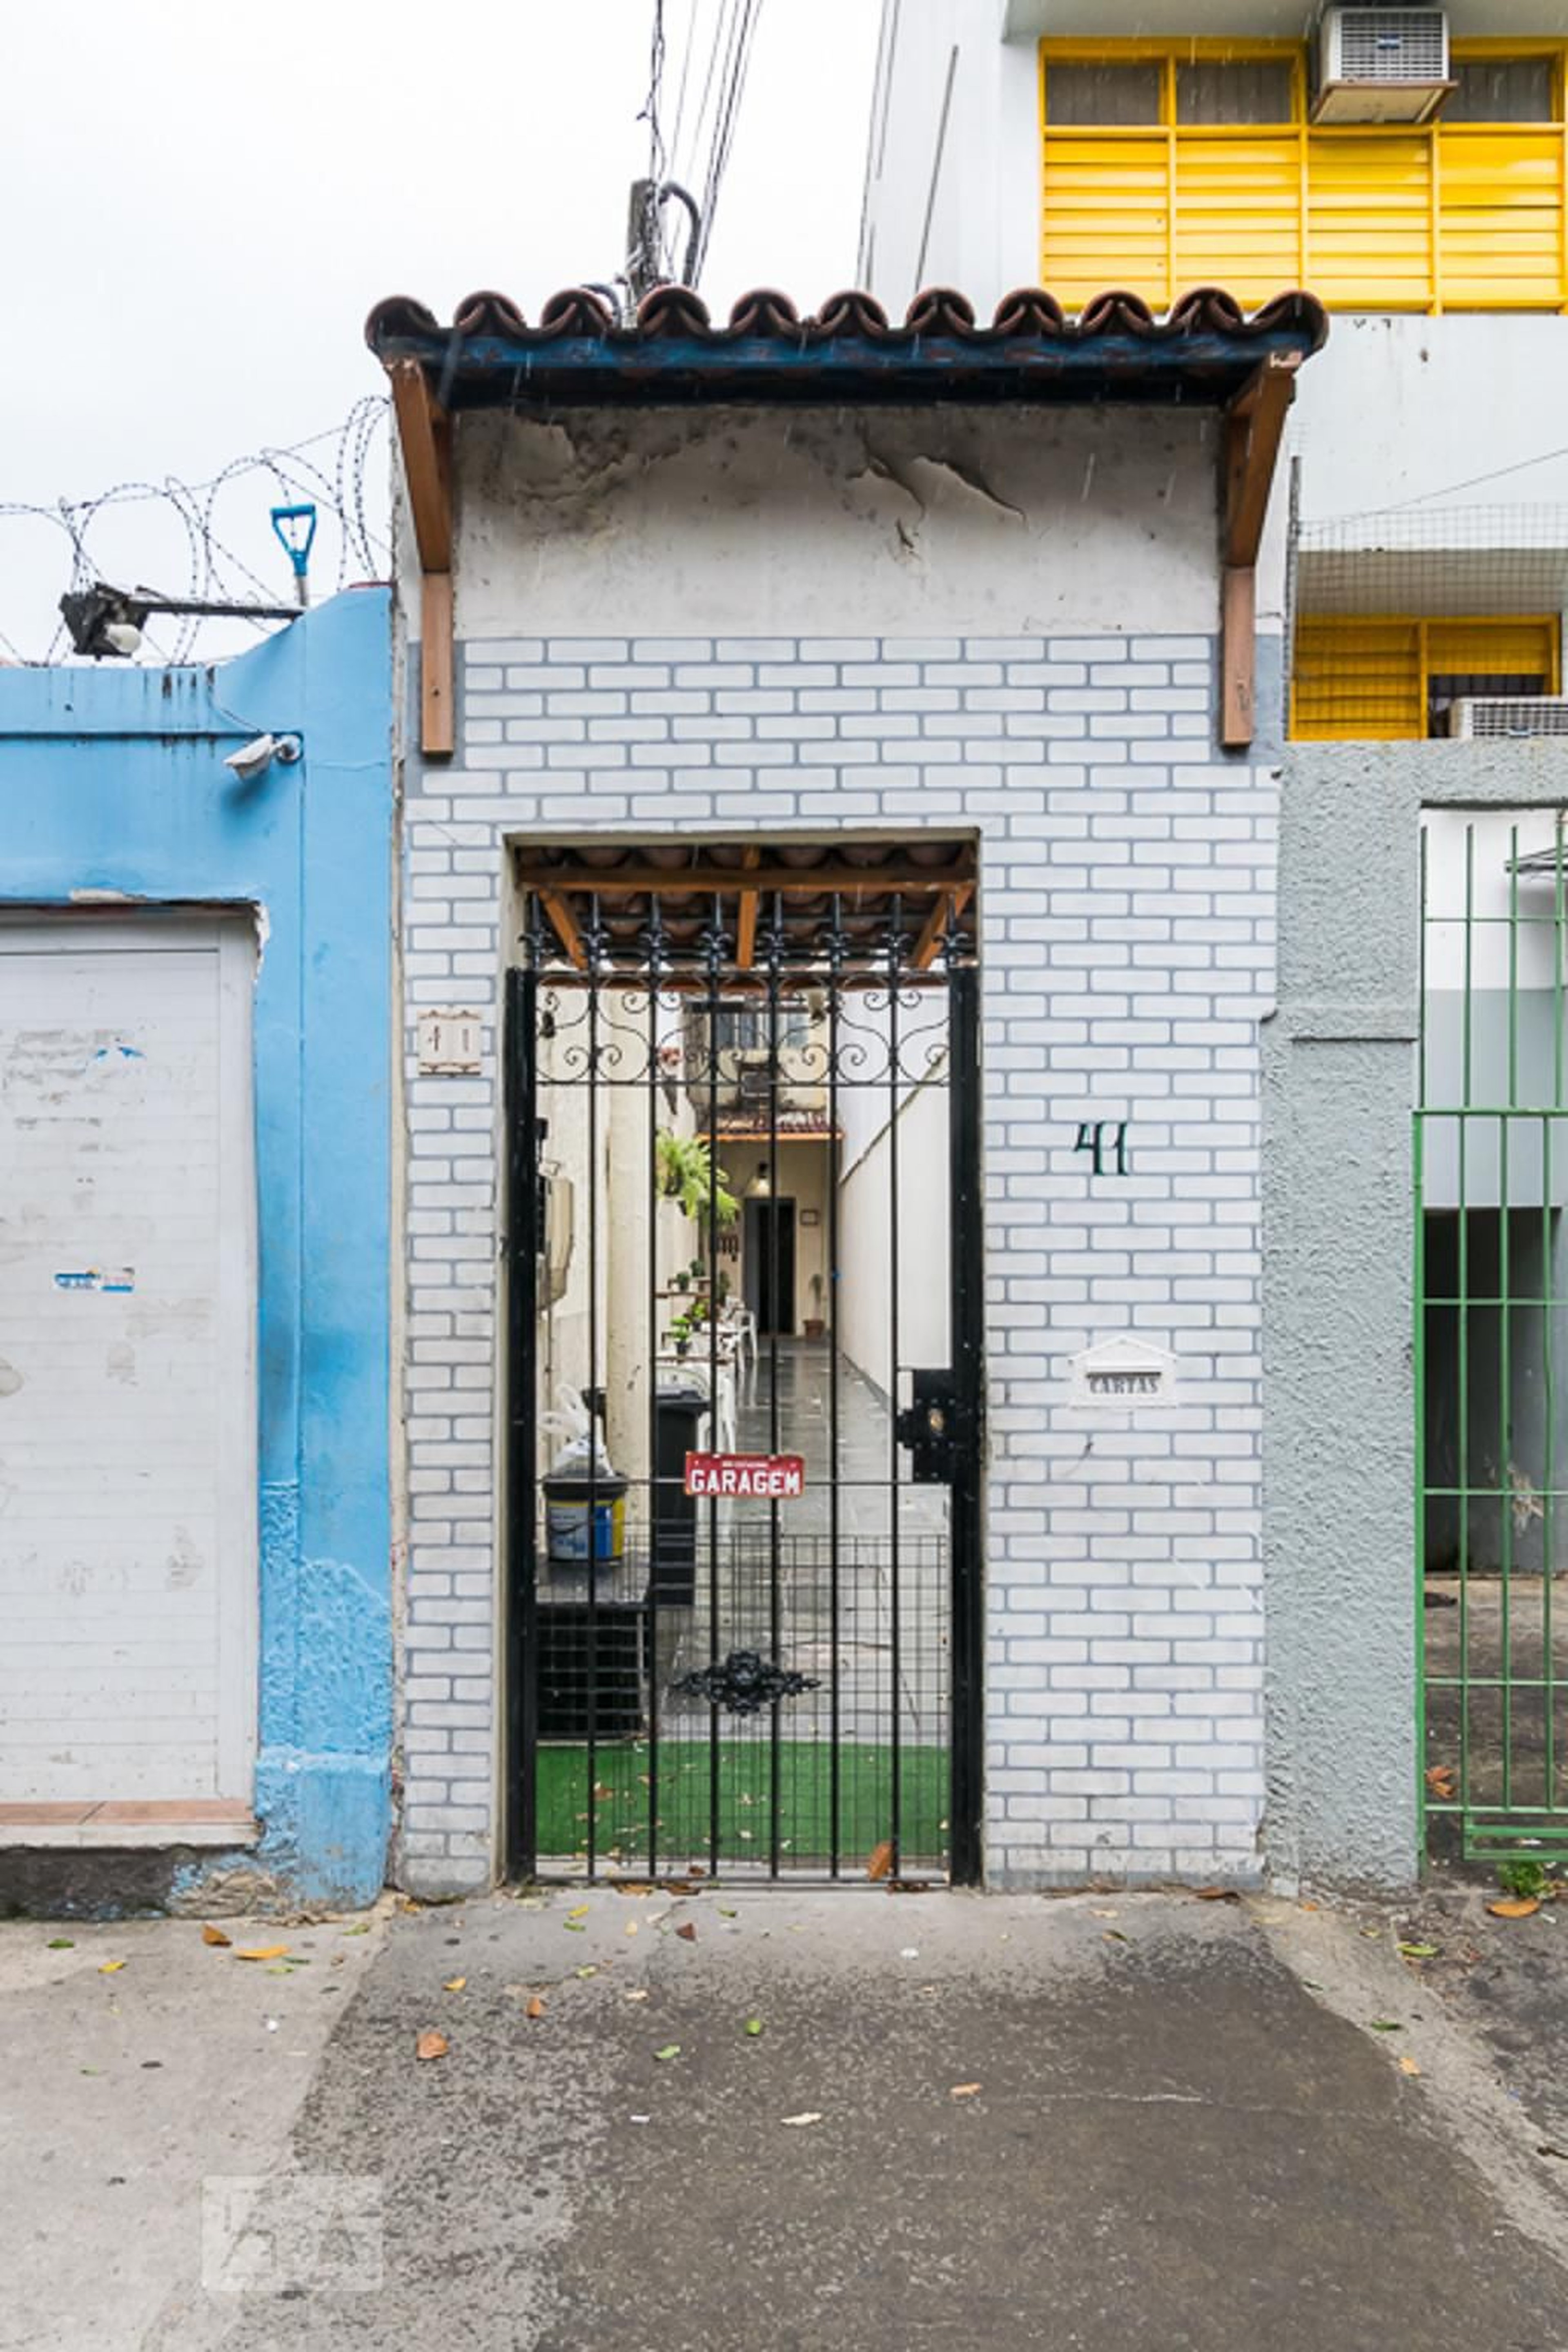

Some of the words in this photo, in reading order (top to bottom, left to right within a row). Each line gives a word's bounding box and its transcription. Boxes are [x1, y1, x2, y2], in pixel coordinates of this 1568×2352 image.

[1074, 1121, 1128, 1176] 41
[1089, 1375, 1158, 1394] CARTAS
[691, 1469, 800, 1495] GARAGEM
